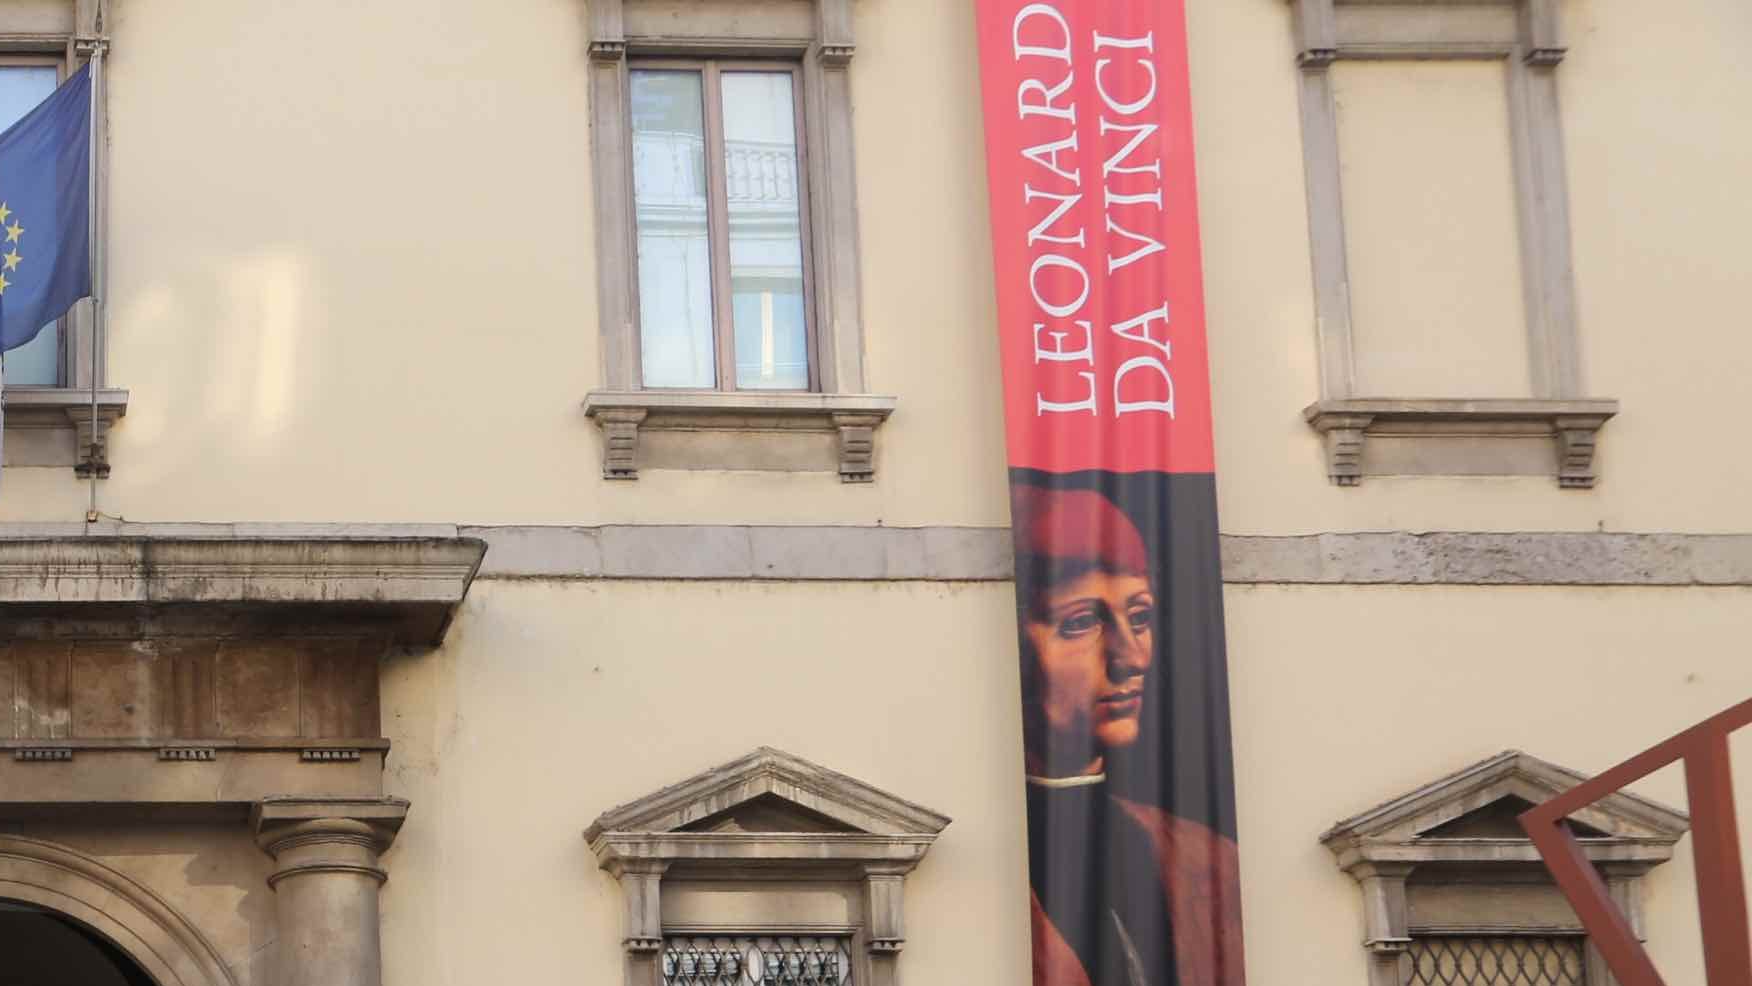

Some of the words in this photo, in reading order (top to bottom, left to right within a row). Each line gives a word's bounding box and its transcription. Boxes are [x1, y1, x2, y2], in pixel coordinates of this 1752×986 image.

[1013, 2, 1097, 417] LEONARD
[1093, 30, 1167, 275] VINCI
[1111, 301, 1175, 420] DA
